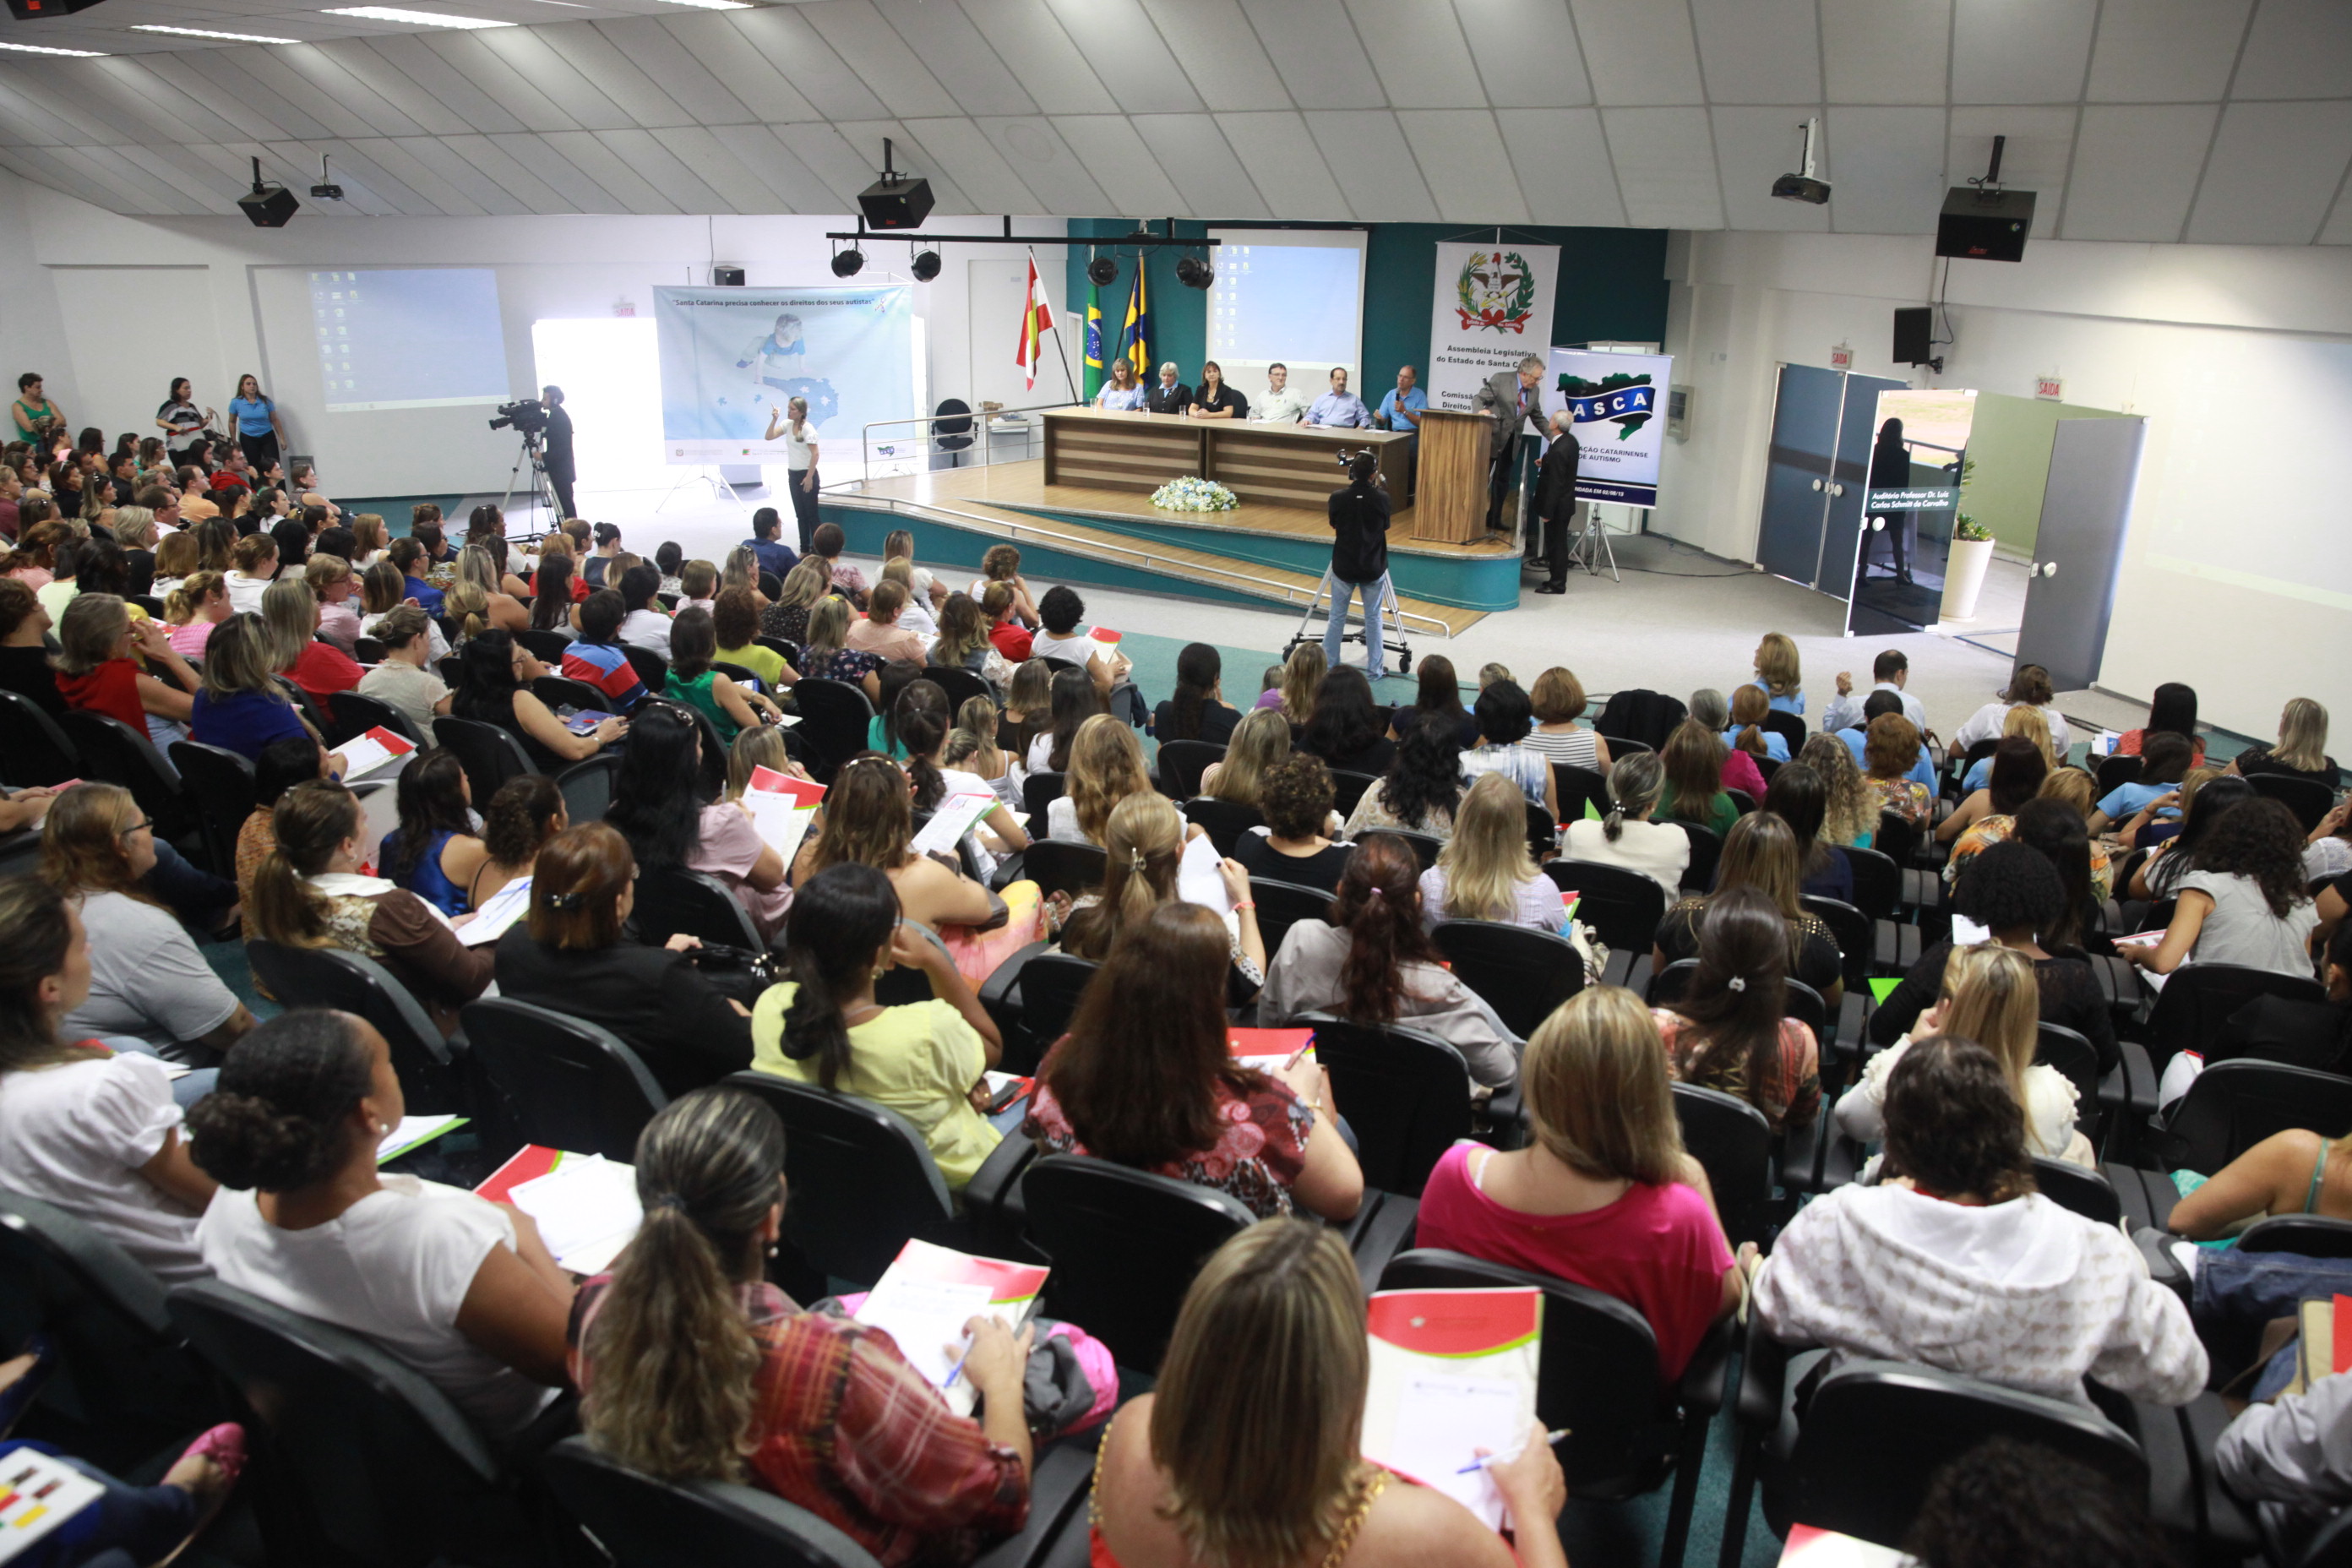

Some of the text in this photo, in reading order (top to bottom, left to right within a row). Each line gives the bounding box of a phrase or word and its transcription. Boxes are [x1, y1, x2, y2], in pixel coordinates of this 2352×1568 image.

[1447, 345, 1537, 357] Assembleia Legislativa
[1448, 357, 1474, 365] Estado
[1441, 391, 1473, 400] Comissã
[1442, 401, 1472, 411] Direitos
[1573, 392, 1647, 417] ASCA
[1600, 448, 1648, 458] CATARINENSE
[1588, 454, 1621, 463] AUTISMO
